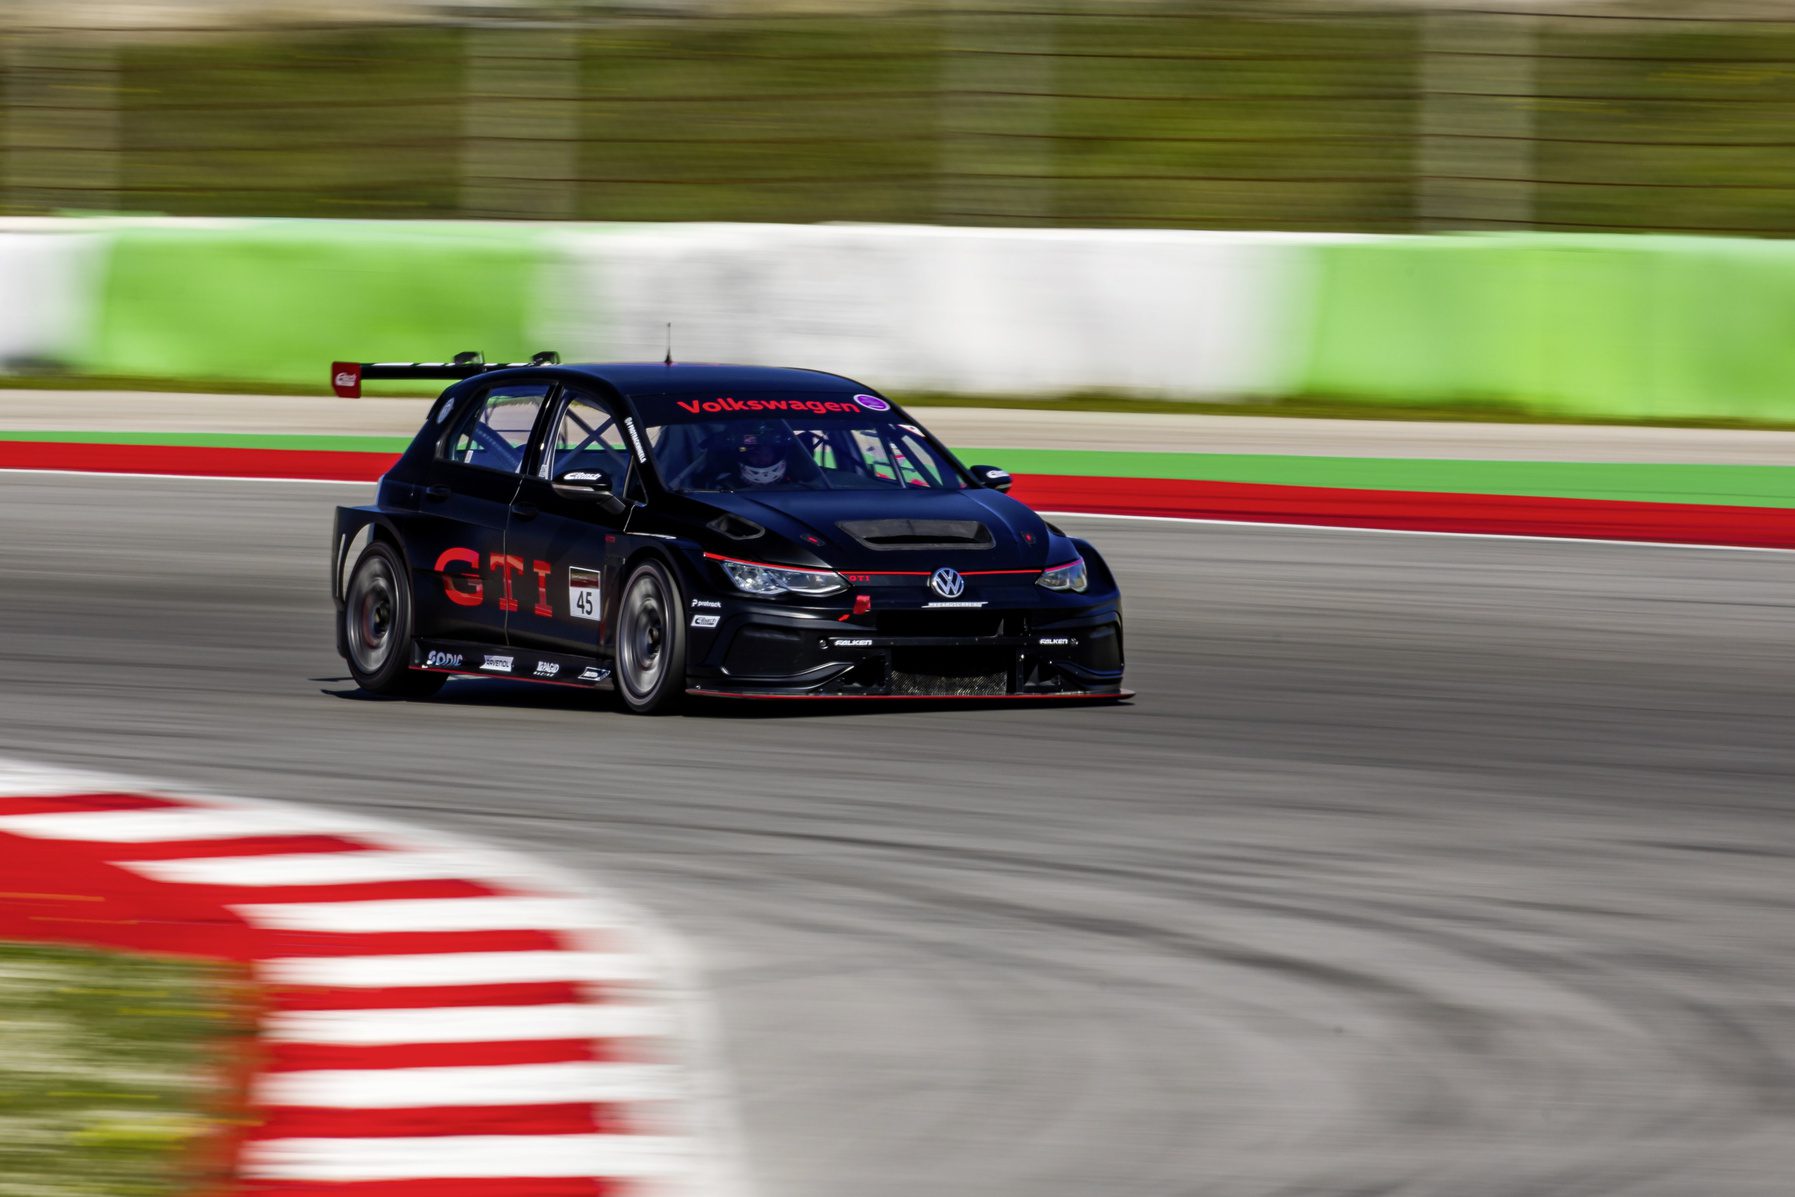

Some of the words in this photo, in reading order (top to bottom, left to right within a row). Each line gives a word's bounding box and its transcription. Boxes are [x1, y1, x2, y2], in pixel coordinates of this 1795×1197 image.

[677, 397, 860, 414] Volkswagen
[434, 547, 552, 618] GTI
[577, 590, 593, 616] 45
